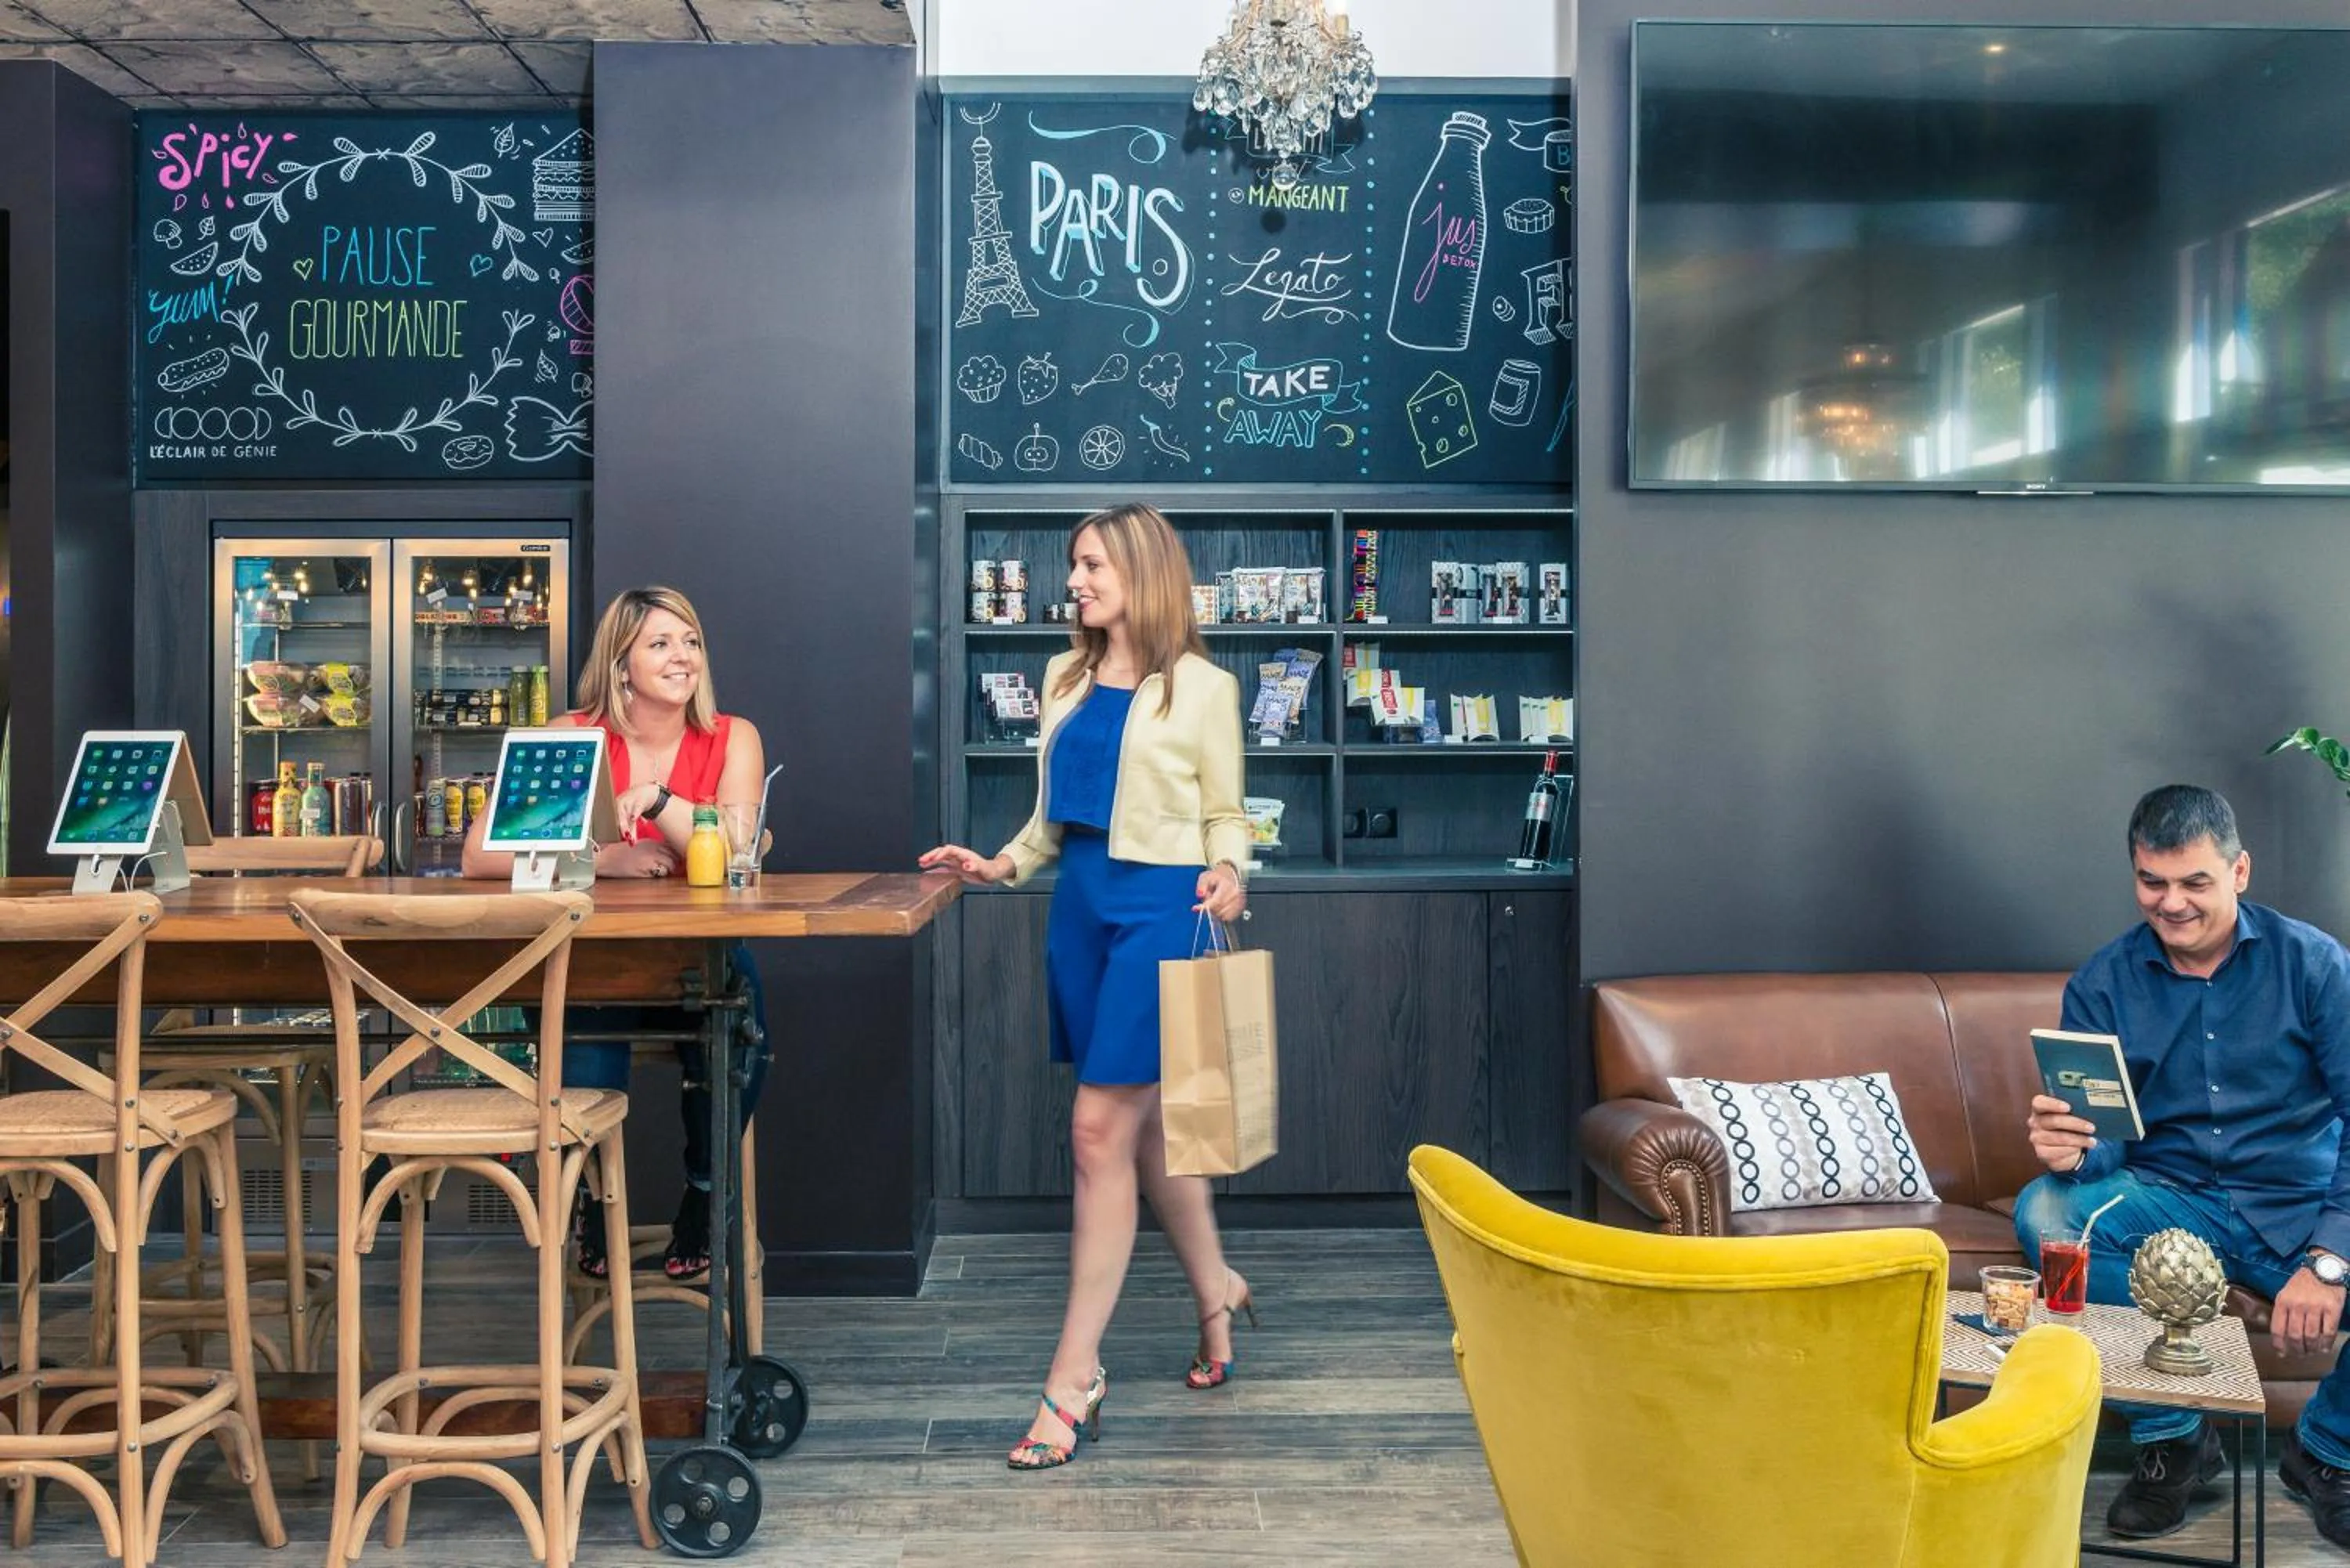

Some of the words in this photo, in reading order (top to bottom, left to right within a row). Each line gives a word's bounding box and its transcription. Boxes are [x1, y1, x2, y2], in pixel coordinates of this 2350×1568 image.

[1248, 184, 1350, 213] MANGEANT
[321, 225, 437, 287] PAUSE
[1030, 161, 1195, 315] PARIS
[1442, 253, 1477, 269] DETOX
[1220, 247, 1354, 322] Legato
[289, 298, 468, 359] GOURMANDE
[1243, 365, 1331, 398] TAKE
[1223, 410, 1323, 448] AWAY
[150, 444, 206, 458] L'ÉCLAIR
[211, 445, 227, 457] DE
[234, 444, 277, 458] GÉNIE
